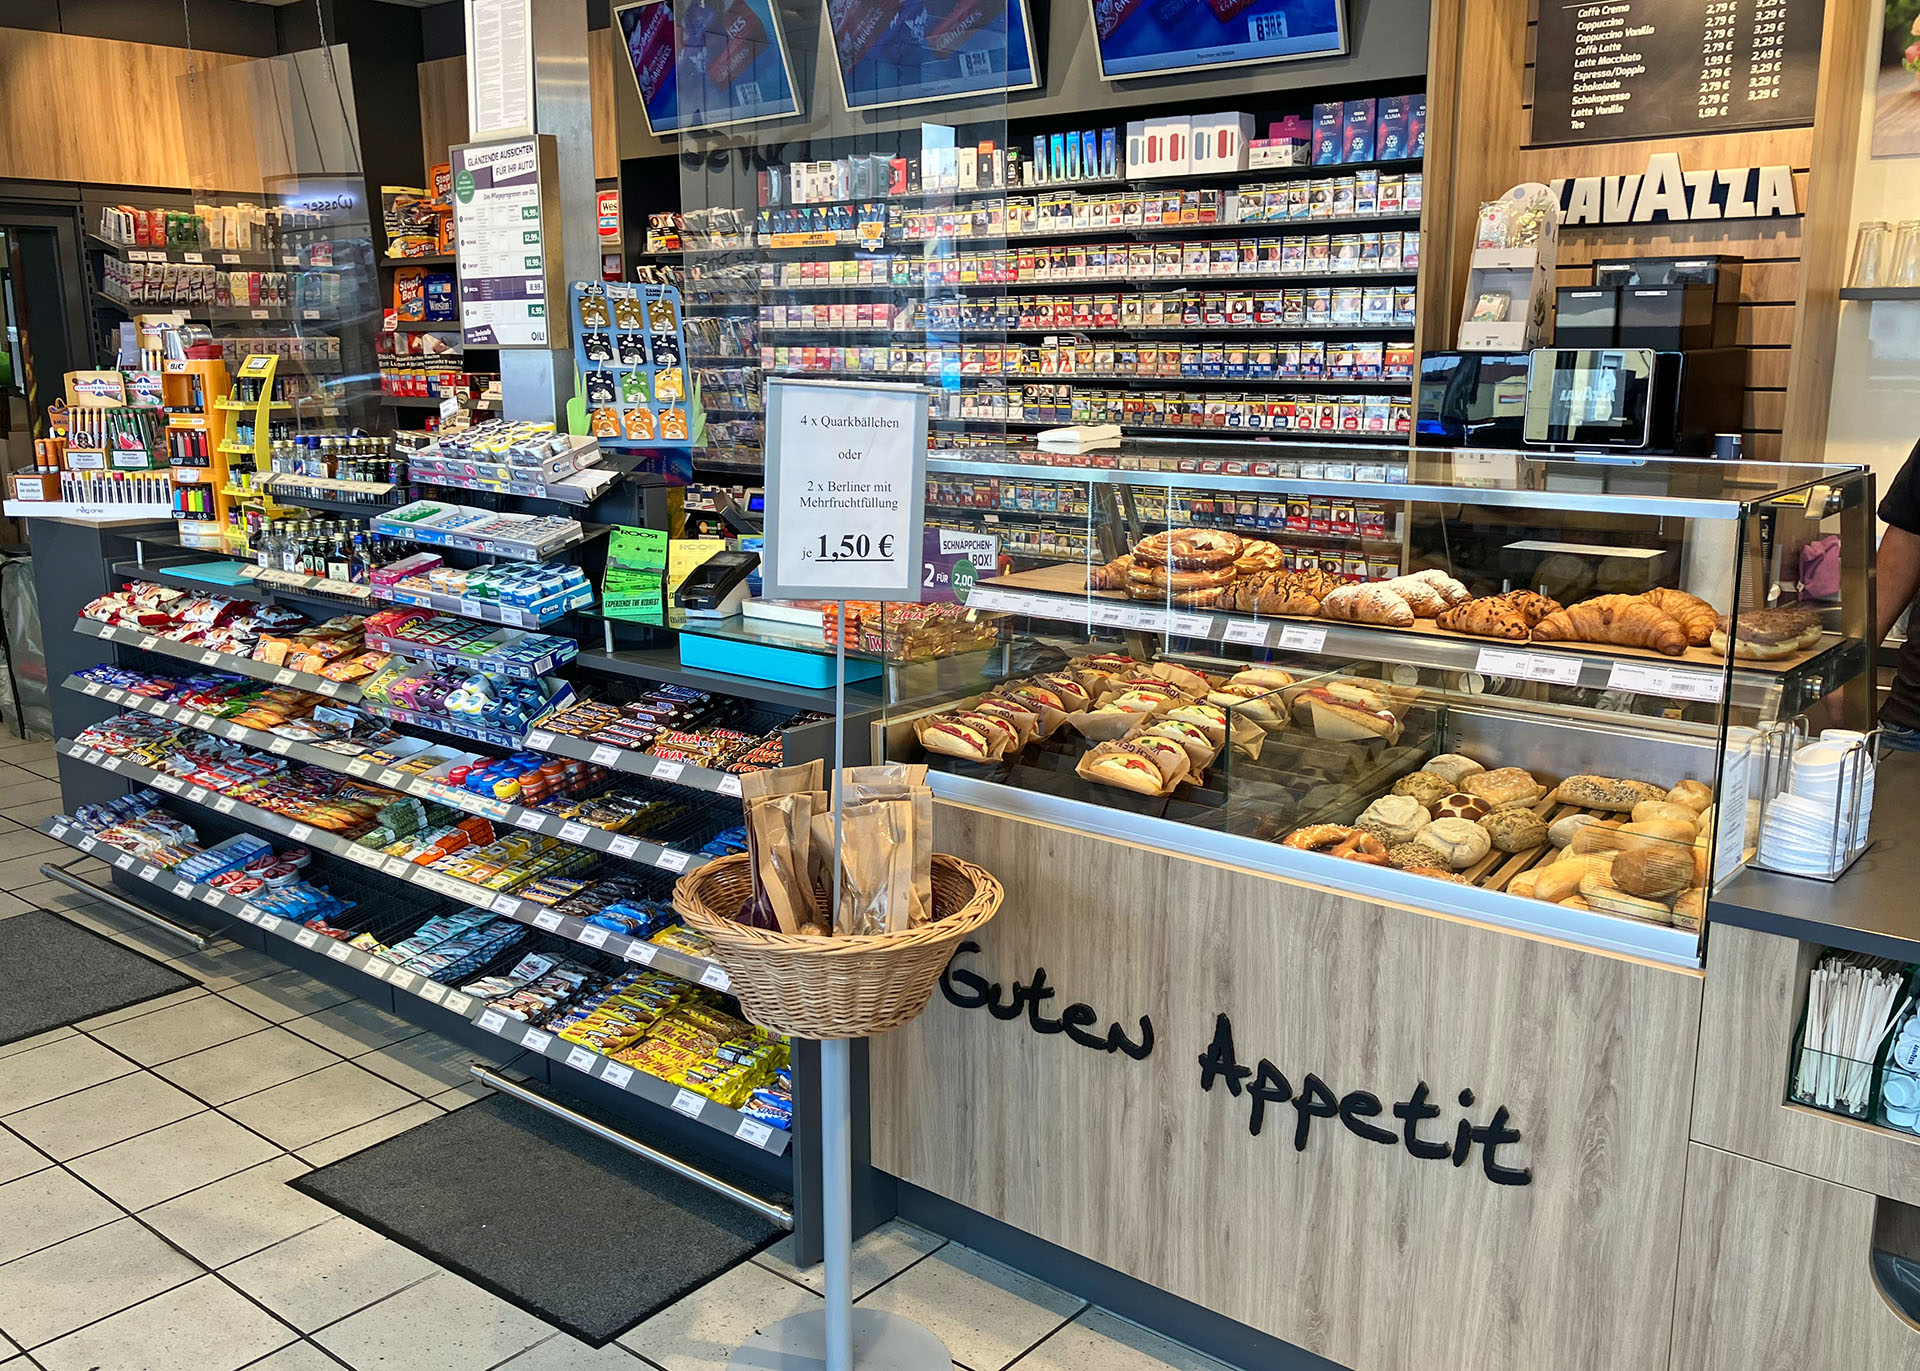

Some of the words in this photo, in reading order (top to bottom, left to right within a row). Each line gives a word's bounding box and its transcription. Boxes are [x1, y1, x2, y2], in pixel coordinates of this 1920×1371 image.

[1577, 17, 1624, 32] Cappuccino
[1705, 2, 1728, 15] 2,79
[1729, 1, 1738, 11] €
[1578, 7, 1600, 18] Caffè
[1601, 4, 1630, 15] Crema
[1576, 30, 1623, 44] Cappuccino
[1625, 25, 1655, 37] Vanilla
[1704, 15, 1727, 28] 2,79
[1728, 14, 1737, 24] €
[1754, 10, 1777, 21] 3,29
[1778, 9, 1787, 18] €
[1575, 44, 1598, 56] Caffè
[1599, 43, 1622, 53] Latte
[1703, 28, 1726, 41] 2,79
[1727, 27, 1736, 38] €
[1753, 23, 1776, 35] 3,29
[1777, 22, 1786, 31] €
[1574, 58, 1597, 68] Latte
[1598, 53, 1642, 65] Macchiato
[1702, 42, 1725, 54] 2,79
[1725, 41, 1734, 51] €
[1752, 36, 1774, 48] 3,29
[1776, 35, 1785, 45] €
[1573, 65, 1646, 82] Espresso/Doppio
[1704, 55, 1724, 66] 1,99
[1724, 54, 1733, 64] €
[1751, 49, 1774, 61] 2,49
[1775, 49, 1783, 58] €
[1572, 79, 1621, 93] Schokolade
[1700, 68, 1722, 80] 2,79
[1723, 66, 1732, 77] €
[1750, 63, 1772, 74] 3,29
[1773, 62, 1782, 71] €
[1571, 92, 1631, 105] Schokopresso
[1699, 80, 1721, 93] 2,79
[1722, 80, 1731, 90] €
[1748, 76, 1771, 87] 3,29
[1772, 75, 1781, 85] €
[1570, 108, 1593, 118] Latte
[1595, 104, 1625, 116] Vanilla
[1698, 93, 1721, 106] 2,79
[1721, 92, 1730, 103] €
[1747, 89, 1770, 101] 3,29
[1771, 88, 1780, 98] €
[1570, 120, 1586, 130] Tee
[1698, 107, 1718, 119] 1,99
[1720, 106, 1729, 116] €
[467, 151, 499, 167] GLÄNZENDE
[500, 144, 534, 159] AUSSICHTEN
[495, 164, 506, 176] FÜR
[508, 163, 517, 174] IHR
[1550, 152, 1797, 225] LAVAZZA
[602, 202, 618, 211] Wes
[429, 300, 450, 311] Winston
[800, 415, 807, 426] 4
[811, 418, 818, 426] x
[820, 415, 900, 429] Quarkbällchen
[838, 449, 862, 460] oder
[807, 481, 814, 492] 2
[817, 484, 824, 492] x
[828, 480, 871, 492] Berliner
[874, 482, 892, 492] mit
[800, 496, 899, 511] Mehrfruchtfüllung
[801, 546, 813, 561] je
[818, 534, 870, 562] 1,50
[878, 534, 895, 558] €
[943, 537, 993, 551] SCHNÄPPCHEN-
[972, 554, 992, 568] BOX!
[923, 563, 935, 588] 2
[937, 571, 949, 584] FÜR
[954, 573, 974, 587] 2,00
[541, 603, 559, 616] extra
[605, 599, 632, 608] EXPERIENCE
[667, 731, 702, 744] TWIX
[653, 746, 688, 761] TWIX
[1199, 1012, 1533, 1186] Appetit
